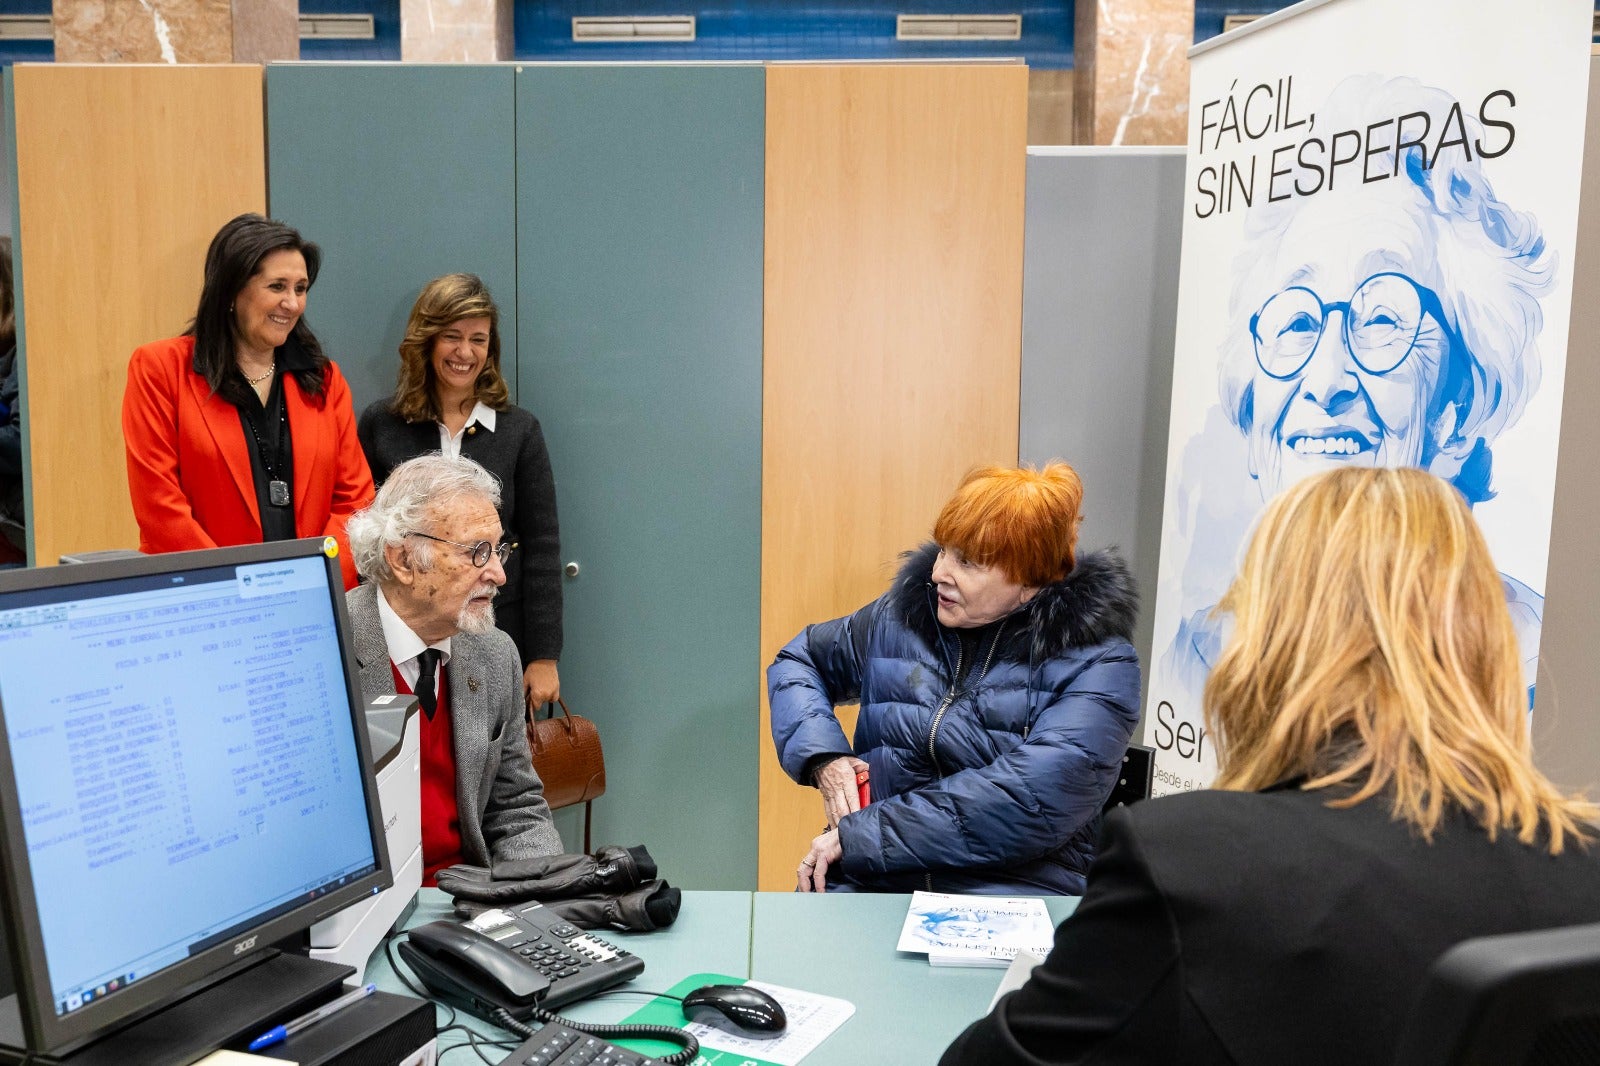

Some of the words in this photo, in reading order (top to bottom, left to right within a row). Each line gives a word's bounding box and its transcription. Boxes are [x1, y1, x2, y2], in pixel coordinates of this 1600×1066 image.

[1199, 75, 1316, 154] FÁCIL,
[1194, 154, 1256, 218] SIN
[1268, 89, 1517, 204] ESPERAS
[1155, 700, 1207, 763] Ser
[234, 934, 258, 955] acer
